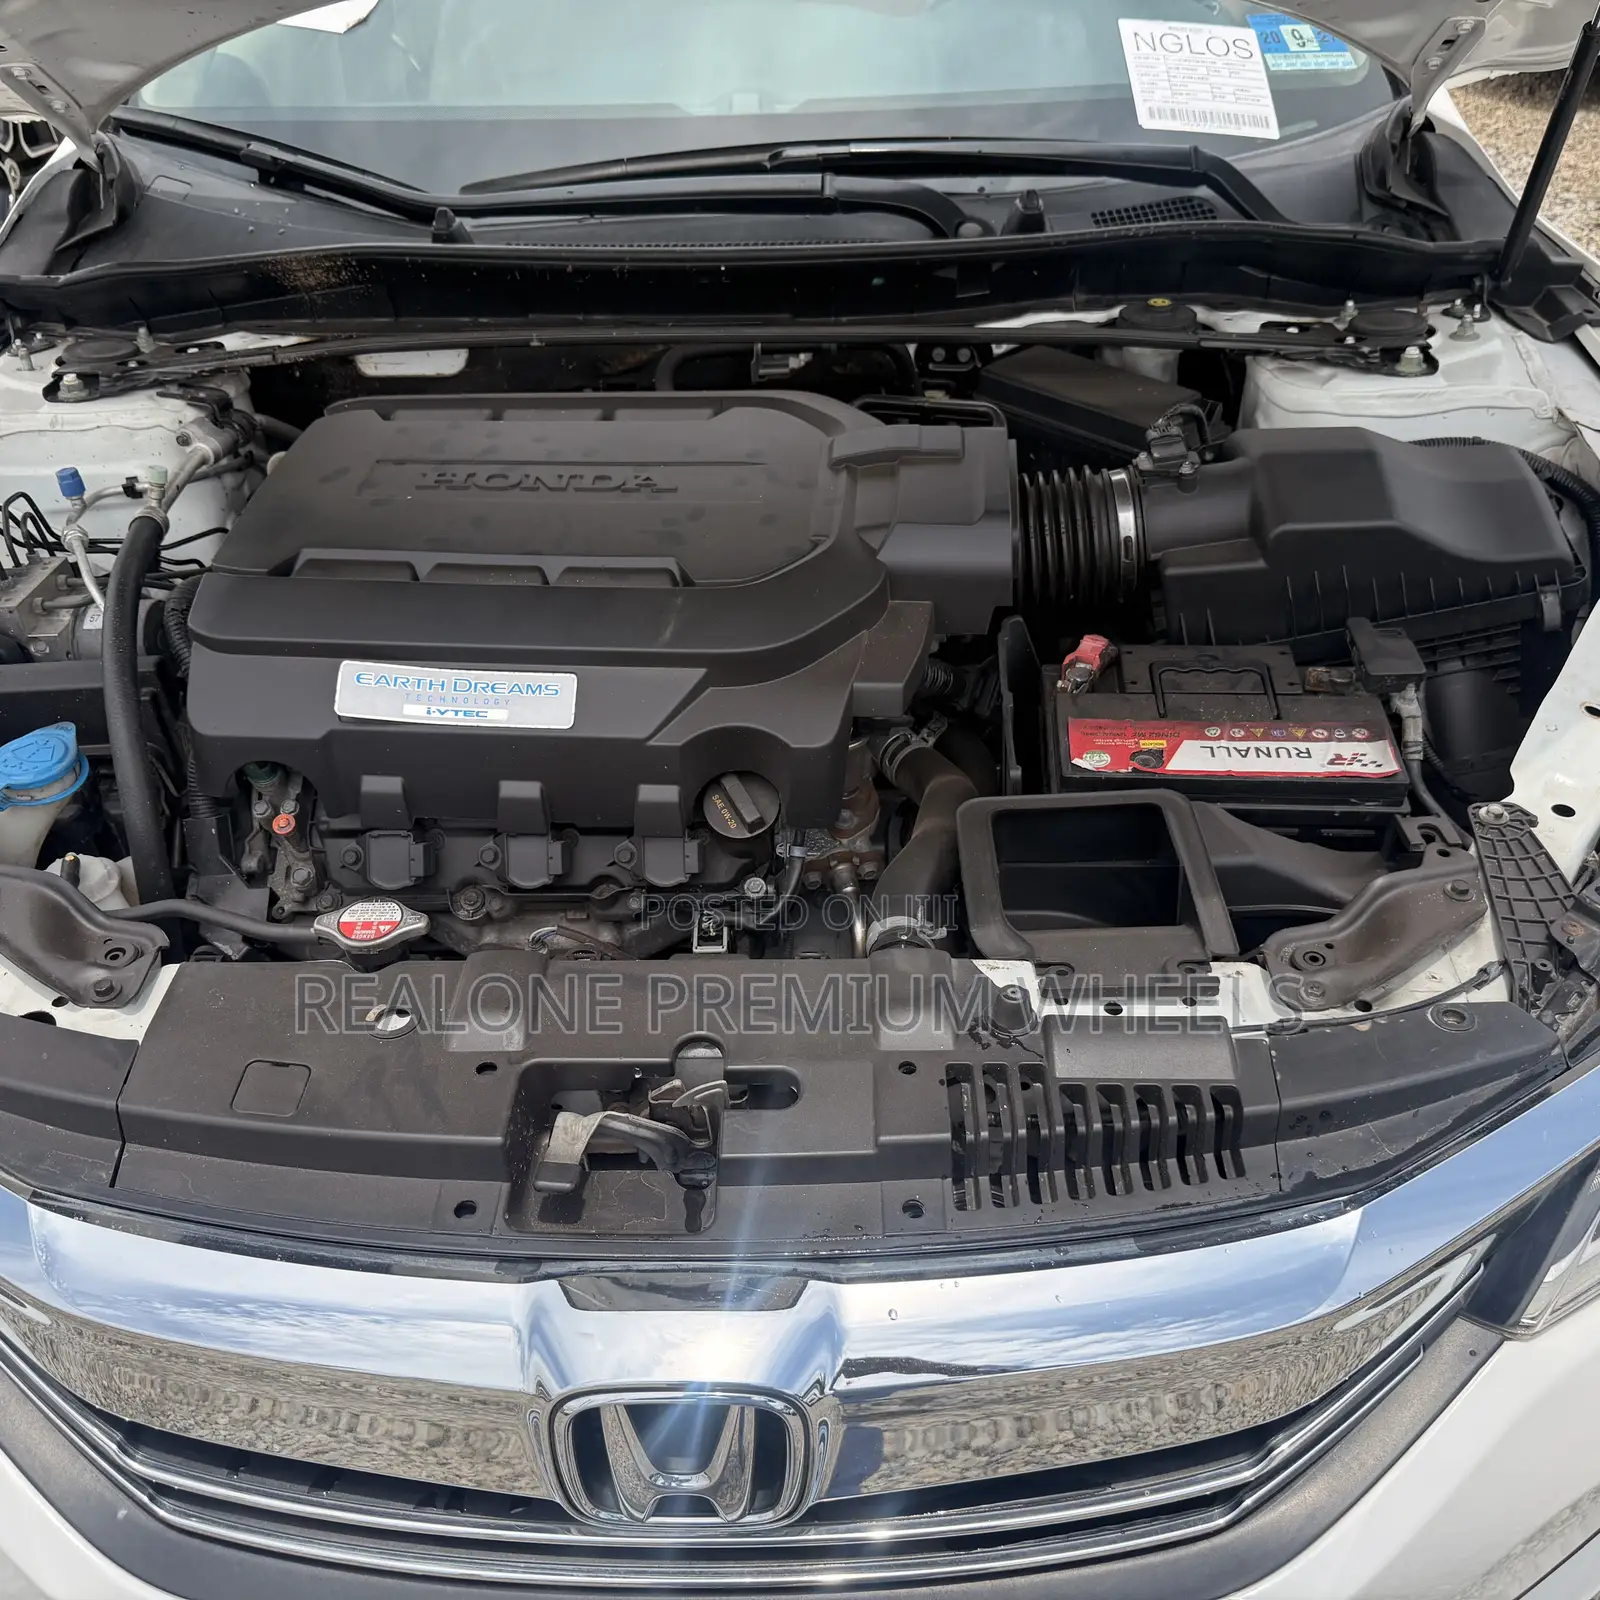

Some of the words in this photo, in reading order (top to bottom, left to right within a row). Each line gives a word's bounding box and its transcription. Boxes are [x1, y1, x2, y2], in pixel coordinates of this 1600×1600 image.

[1260, 31, 1281, 44] 20
[1133, 31, 1253, 60] NGLOS
[414, 472, 679, 494] HONDA
[355, 672, 446, 692] EARTH
[452, 677, 561, 697] DREAMS
[404, 693, 511, 706] TECHNOLOGY
[425, 706, 489, 719] i-VTEC
[1199, 745, 1313, 760] RUNALL
[711, 794, 725, 810] SAE
